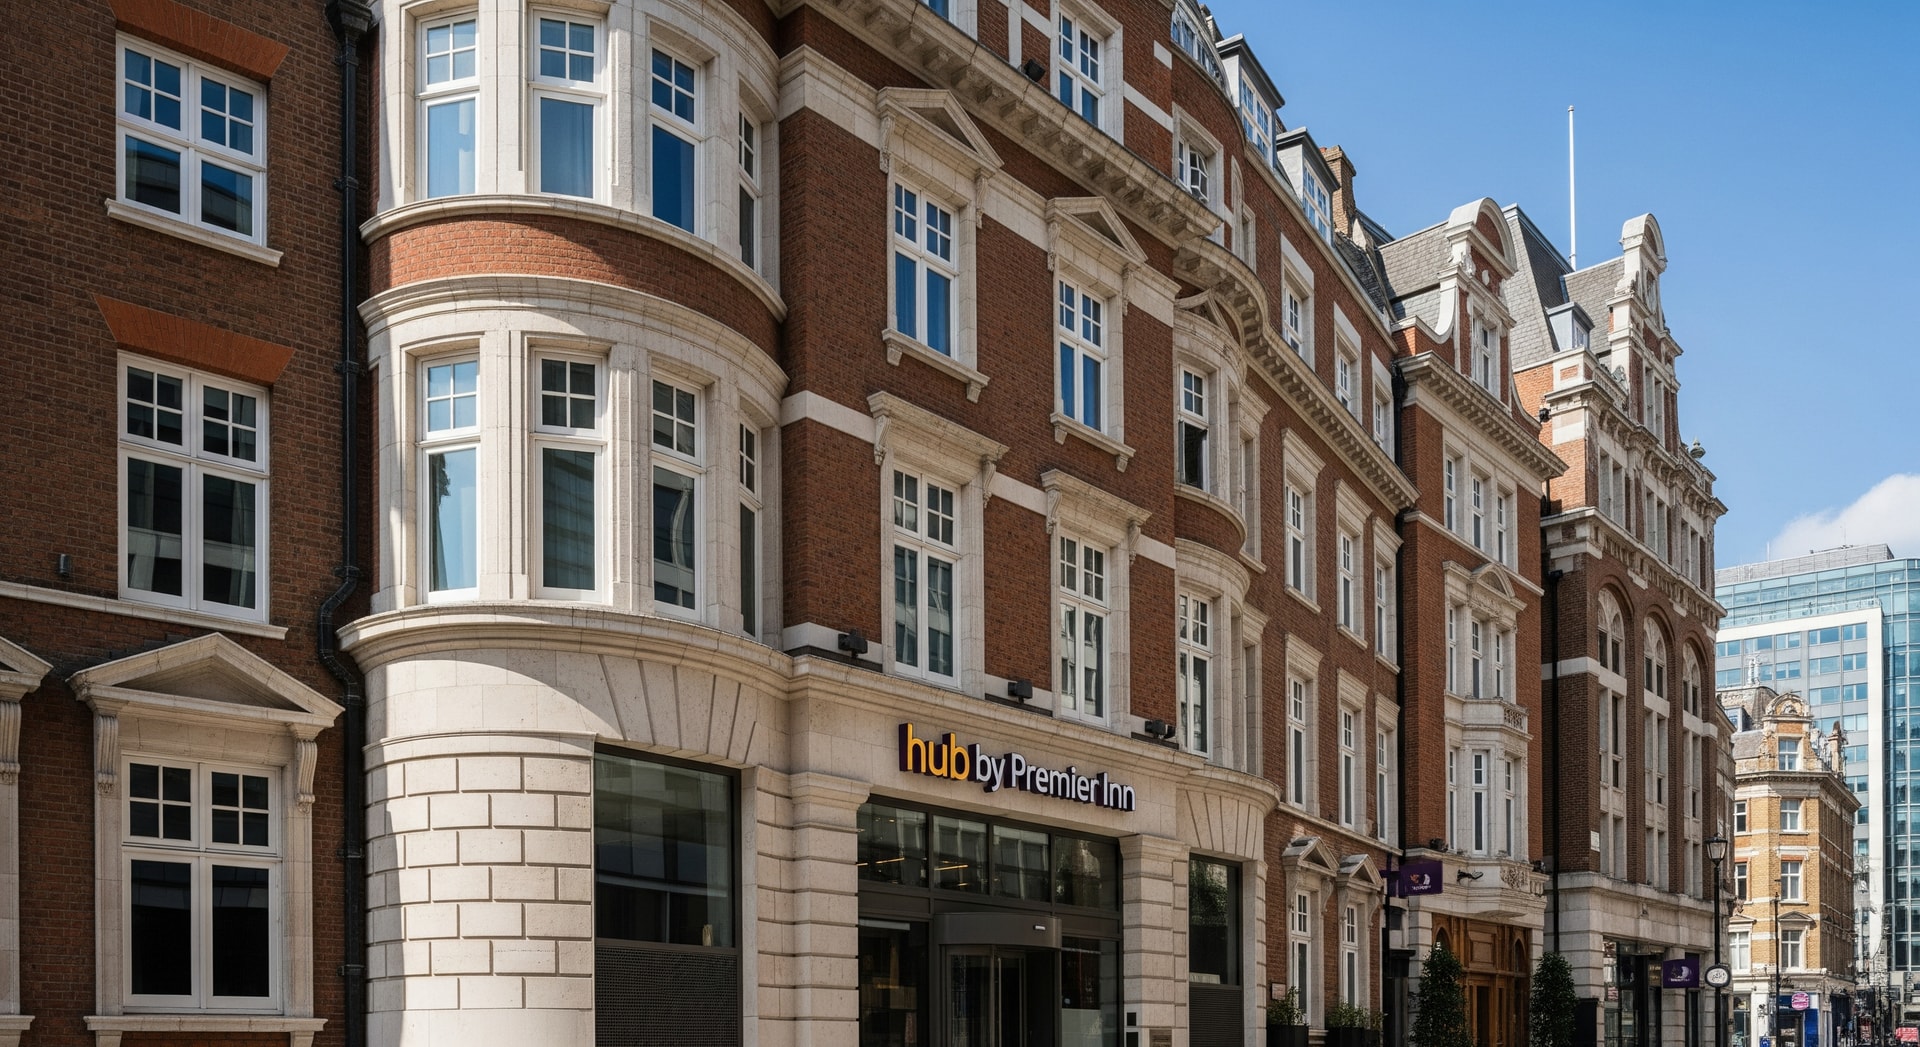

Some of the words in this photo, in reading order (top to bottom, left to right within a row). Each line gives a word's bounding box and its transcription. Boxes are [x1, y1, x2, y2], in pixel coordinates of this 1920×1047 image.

[904, 723, 970, 780] hub
[974, 743, 1005, 792] by
[1010, 752, 1099, 803] Premier
[1101, 772, 1136, 811] Inn
